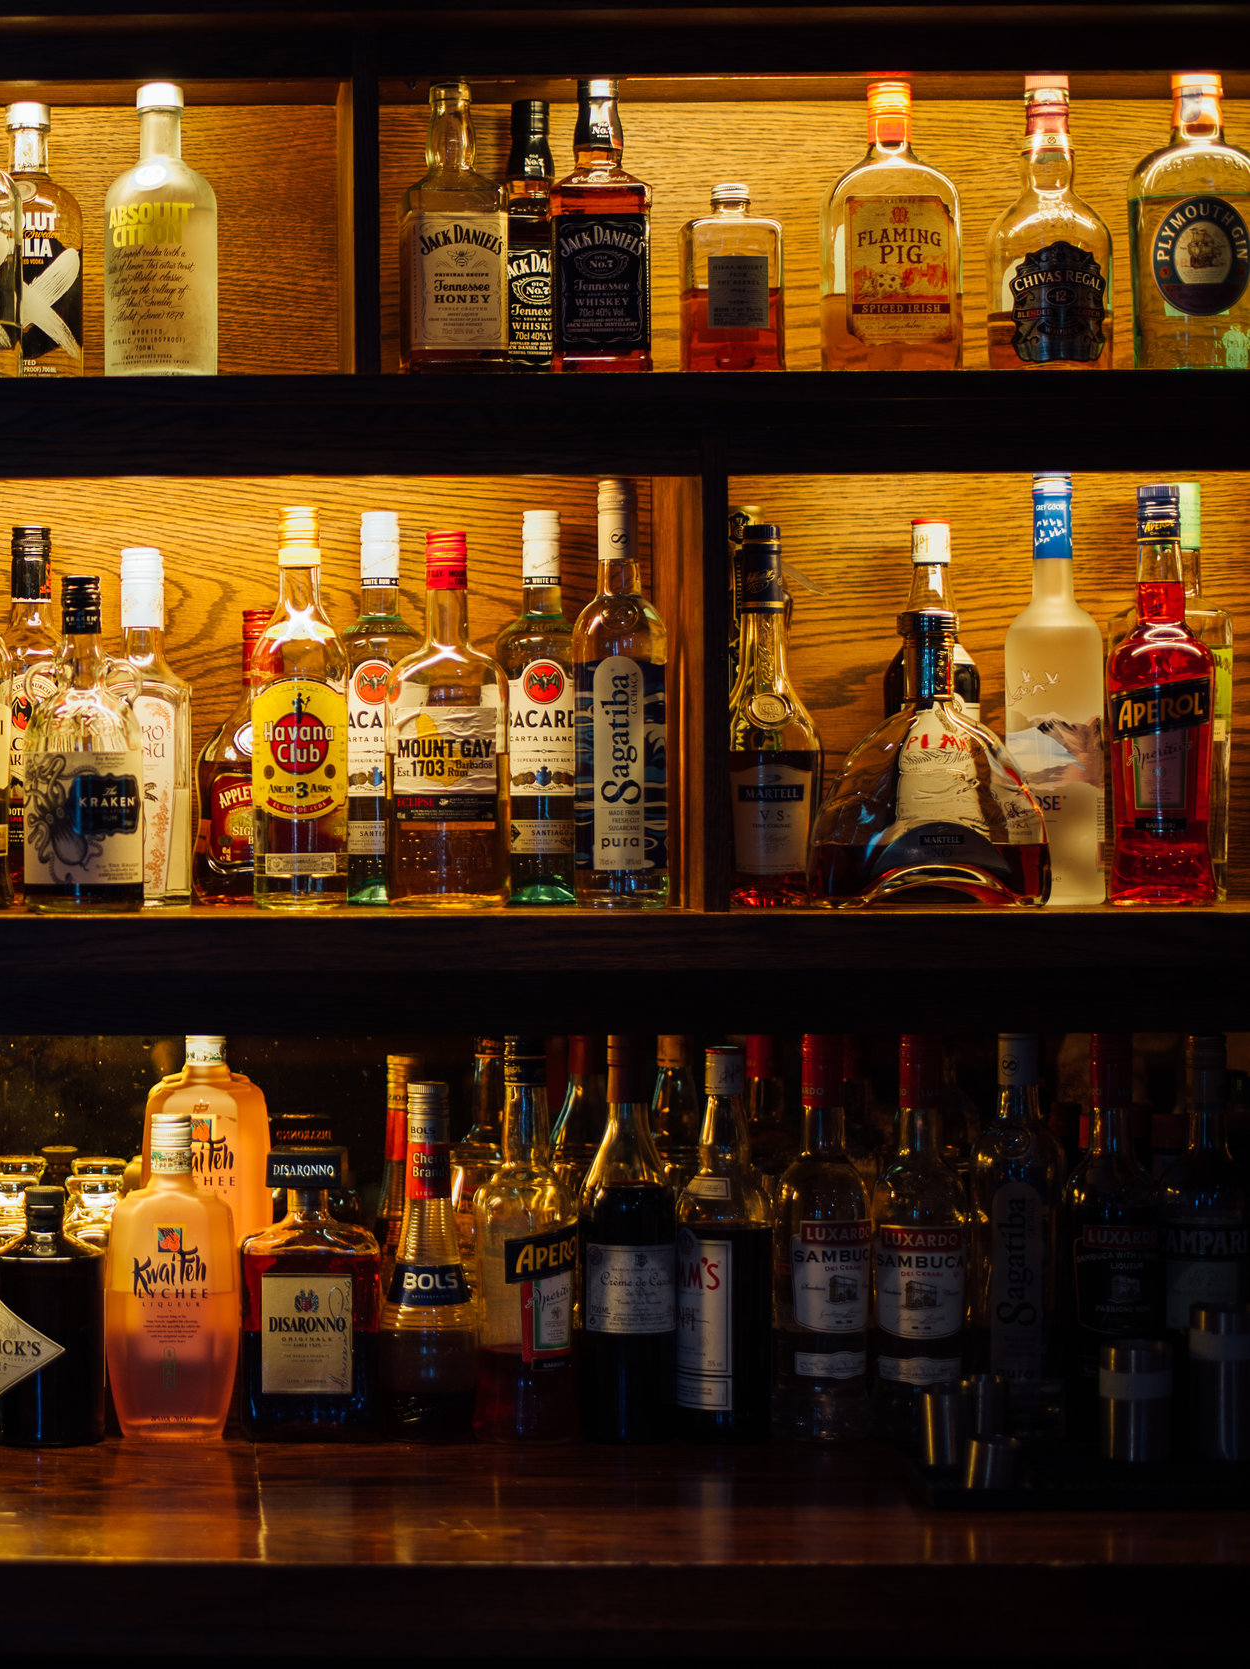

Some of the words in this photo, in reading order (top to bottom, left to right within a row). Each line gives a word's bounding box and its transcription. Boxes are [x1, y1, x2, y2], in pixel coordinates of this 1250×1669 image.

[108, 202, 191, 229] ABSOLUT
[112, 223, 183, 248] CITRON
[419, 228, 453, 256] JACK
[453, 224, 503, 256] DANIEL'S
[559, 231, 593, 257] JACK
[593, 225, 645, 256] DANIEL'S
[857, 228, 942, 249] FLAMING
[1157, 203, 1234, 262] PLYMOUTH
[1231, 226, 1249, 261] GIN
[879, 244, 924, 265] PIG
[589, 259, 614, 268] No.7
[433, 280, 490, 292] Tennessee
[573, 280, 630, 291] Tennessee
[1013, 271, 1063, 293] CHIVAS
[1065, 271, 1102, 292] REGAL
[433, 294, 491, 304] HONEY
[575, 297, 629, 307] WHISKEY
[1055, 290, 1068, 302] 12
[861, 303, 905, 314] SPICED
[907, 303, 941, 313] IRISH
[1017, 309, 1053, 318] BLENDED
[1035, 503, 1048, 511] GREY
[1144, 520, 1175, 532] APEROL
[363, 578, 379, 586] WHITE
[380, 578, 391, 586] RUM
[510, 710, 574, 729] BACARD
[1118, 694, 1203, 732] APEROL
[263, 720, 335, 743] Havana
[600, 673, 642, 806] Sagatiba
[276, 742, 321, 764] Club
[397, 739, 456, 758] MOUNT
[460, 739, 493, 758] GAY
[1126, 740, 1193, 768] Aperitivo
[397, 766, 412, 777] Est.
[411, 760, 445, 777] 1703
[447, 767, 469, 778] Rum
[455, 759, 493, 770] Barbados
[102, 785, 118, 796] The
[296, 781, 309, 799] 3
[745, 787, 800, 799] MARTELL
[78, 796, 136, 808] KRAKEN
[397, 797, 435, 808] ECLIPSE
[601, 836, 640, 850] pura
[923, 835, 962, 845] MARTELL
[932, 847, 953, 858] XO
[410, 1125, 437, 1136] BOLS
[207, 1135, 235, 1169] Feh
[272, 1163, 335, 1176] DISARONNO
[805, 1224, 871, 1244] LUXARDO
[883, 1230, 959, 1248] LUXARDO
[1087, 1229, 1158, 1244] LUXARDO
[515, 1233, 577, 1275] APERO
[877, 1252, 966, 1269] SAMBUCA
[996, 1197, 1037, 1327] Sagatiba
[133, 1250, 177, 1297] Kwai
[175, 1245, 207, 1284] Feh
[402, 1271, 459, 1291] BOLS
[600, 1272, 634, 1289] Crème
[634, 1272, 648, 1287] de
[138, 1287, 209, 1299] LYCHEE
[268, 1316, 347, 1334] DISARONNO
